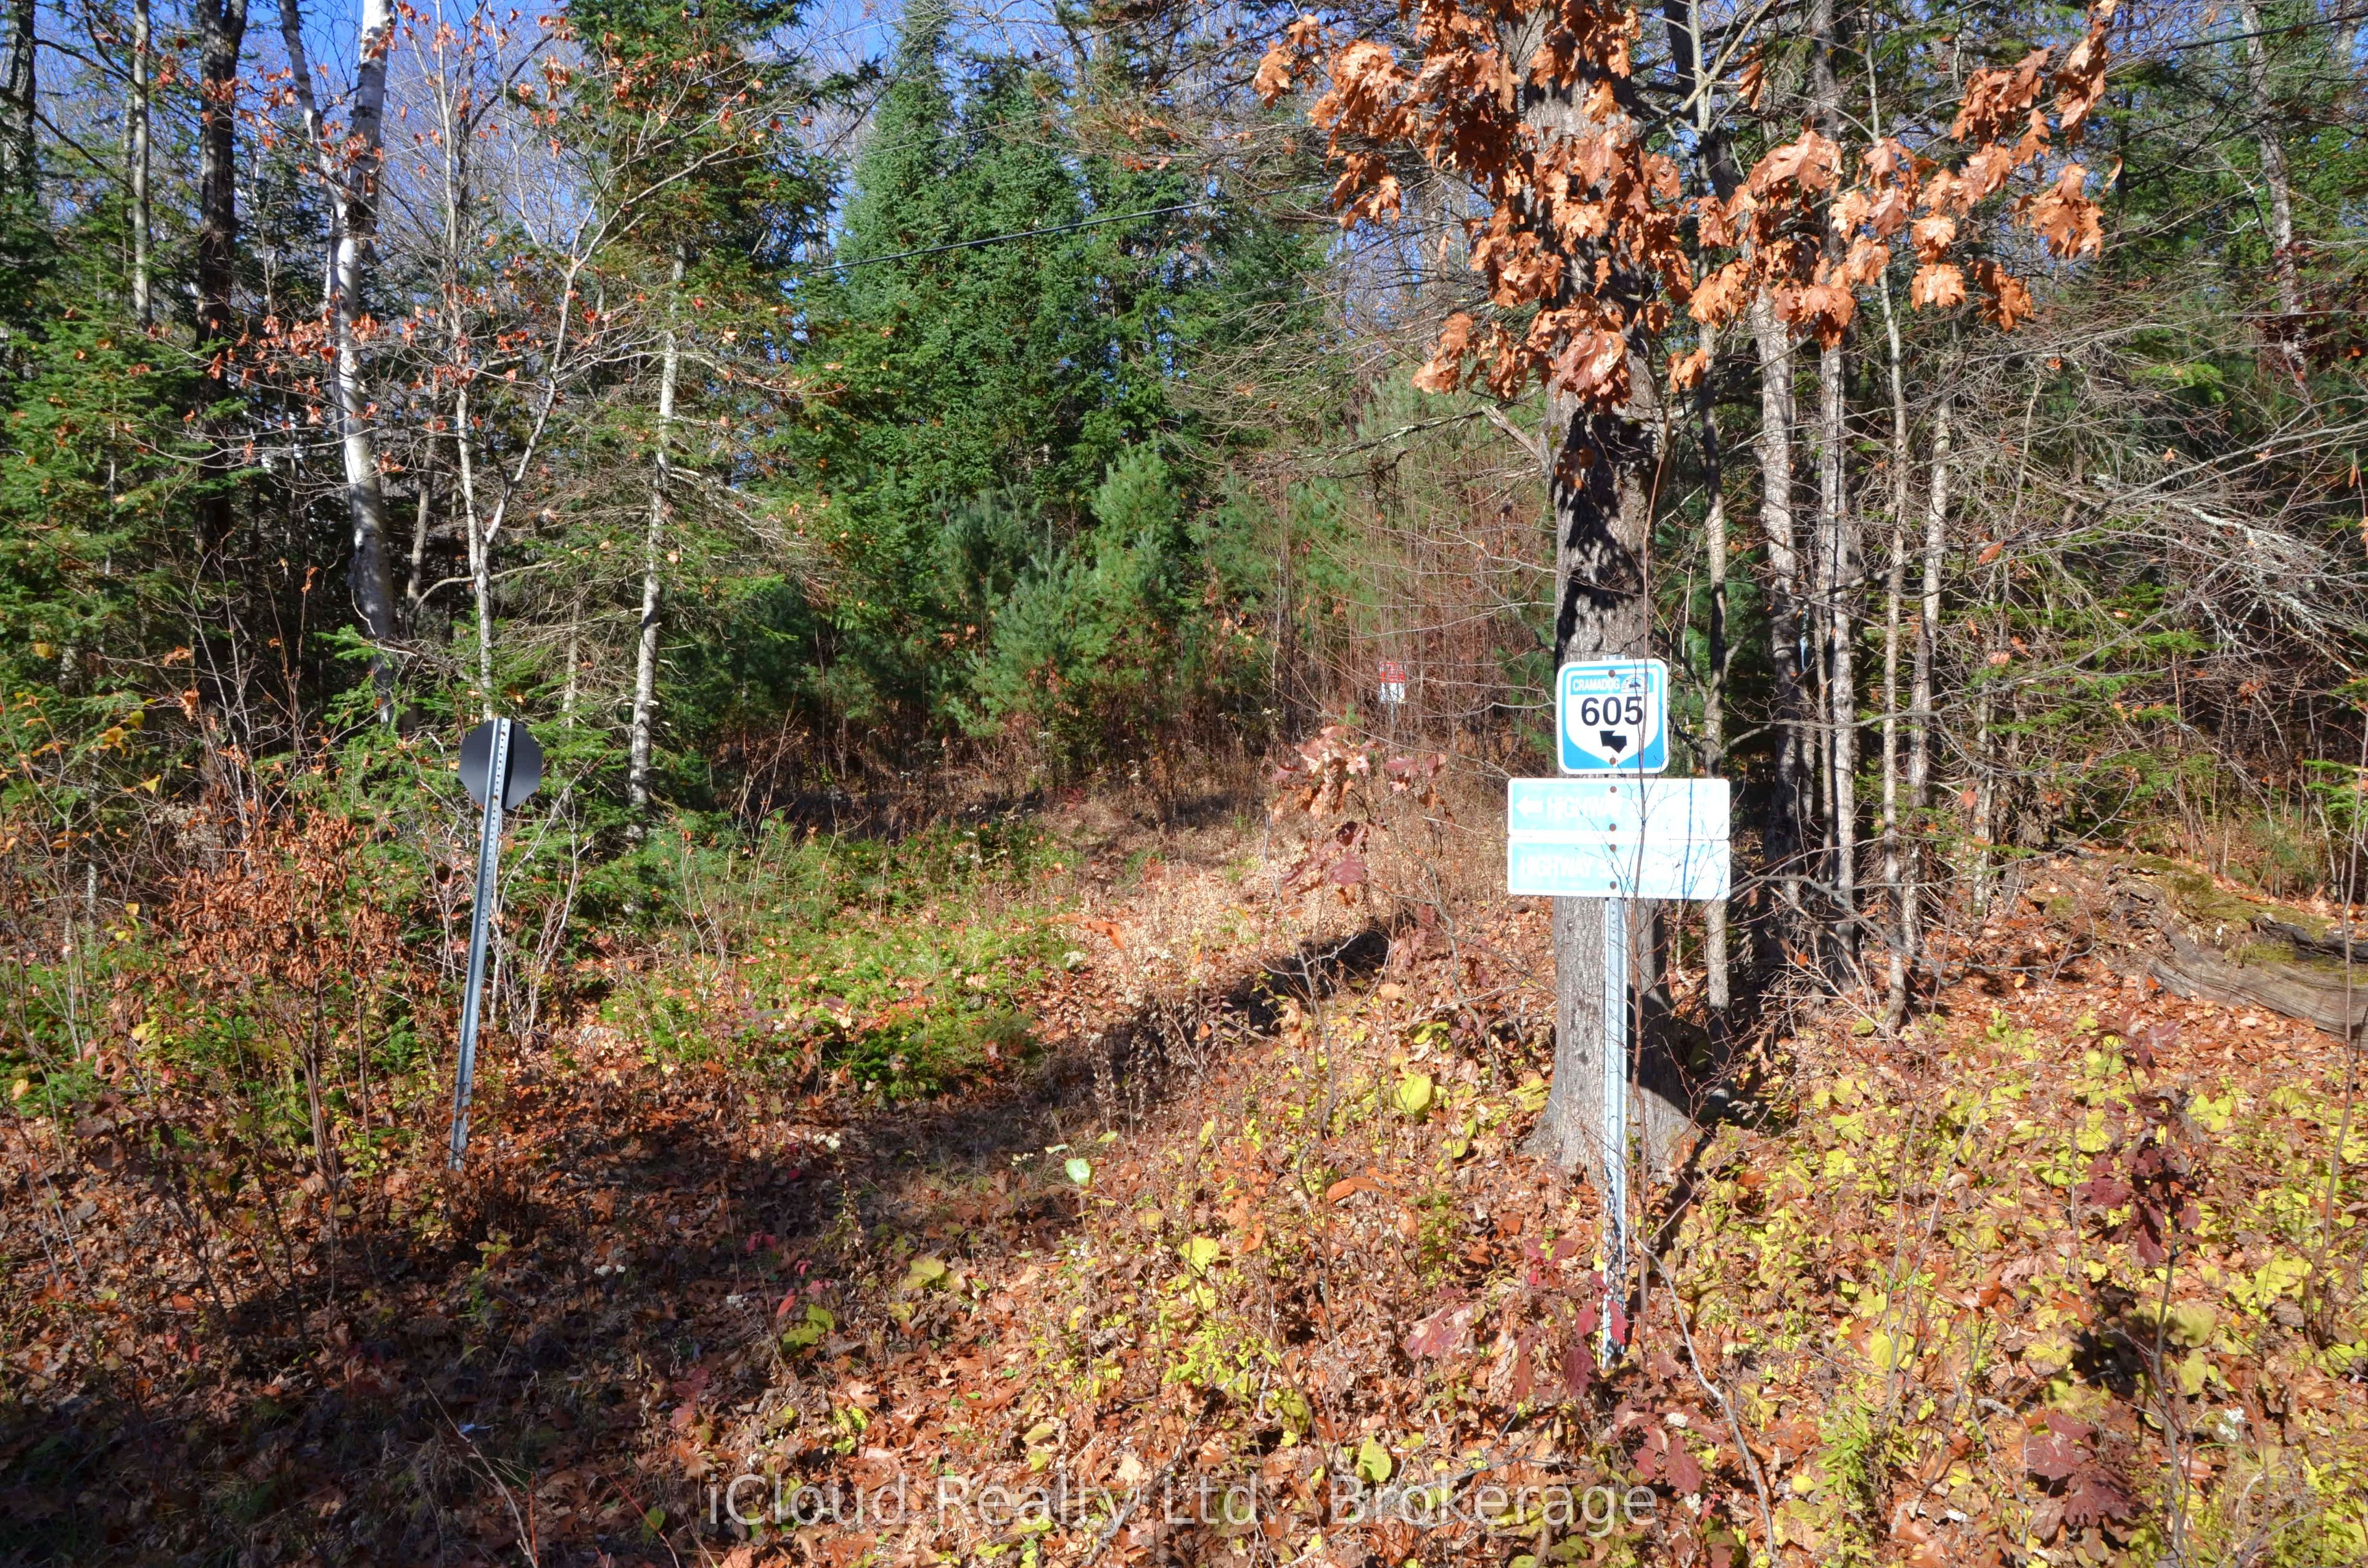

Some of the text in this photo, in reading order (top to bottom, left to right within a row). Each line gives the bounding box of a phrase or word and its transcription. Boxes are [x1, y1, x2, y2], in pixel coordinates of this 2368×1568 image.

[1572, 677, 1621, 692] CRAMADOG
[1581, 696, 1643, 726] 605
[1519, 855, 1593, 879] HIGHWAY
